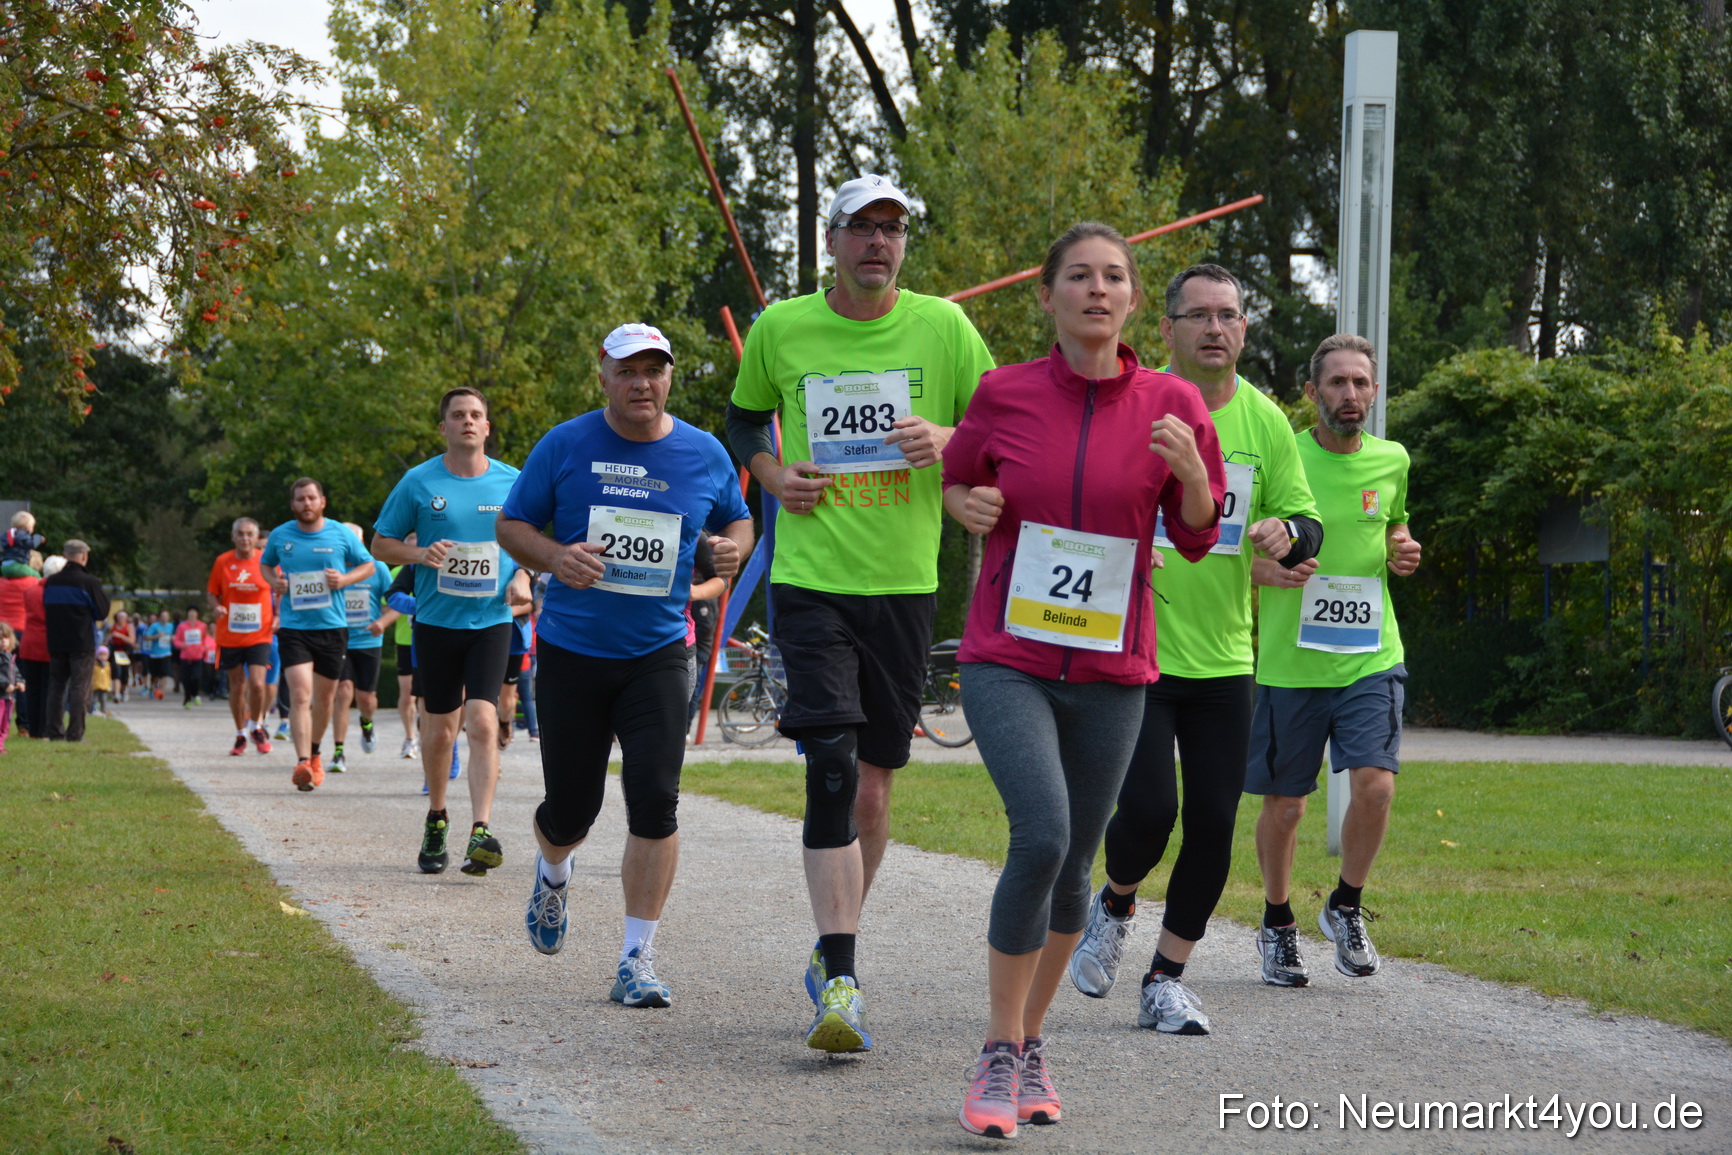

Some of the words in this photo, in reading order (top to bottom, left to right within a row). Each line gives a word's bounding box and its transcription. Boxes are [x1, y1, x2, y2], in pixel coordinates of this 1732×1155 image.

[843, 383, 880, 394] BOCK
[822, 403, 896, 436] 2483
[844, 444, 878, 456] Stefan
[604, 464, 639, 475] HEUTE
[614, 475, 662, 489] MORGEN
[602, 485, 649, 499] BEWEGEN
[816, 487, 910, 508] REISEN
[623, 516, 655, 527] BOCK
[600, 533, 664, 563] 2398
[1063, 540, 1105, 557] BOCK
[448, 558, 490, 576] 2376
[611, 568, 647, 580] Michael
[296, 583, 324, 595] 2403
[454, 580, 482, 588] Christian
[1049, 565, 1093, 602] 24
[1043, 609, 1087, 627] Belinda
[1313, 599, 1371, 624] 2933
